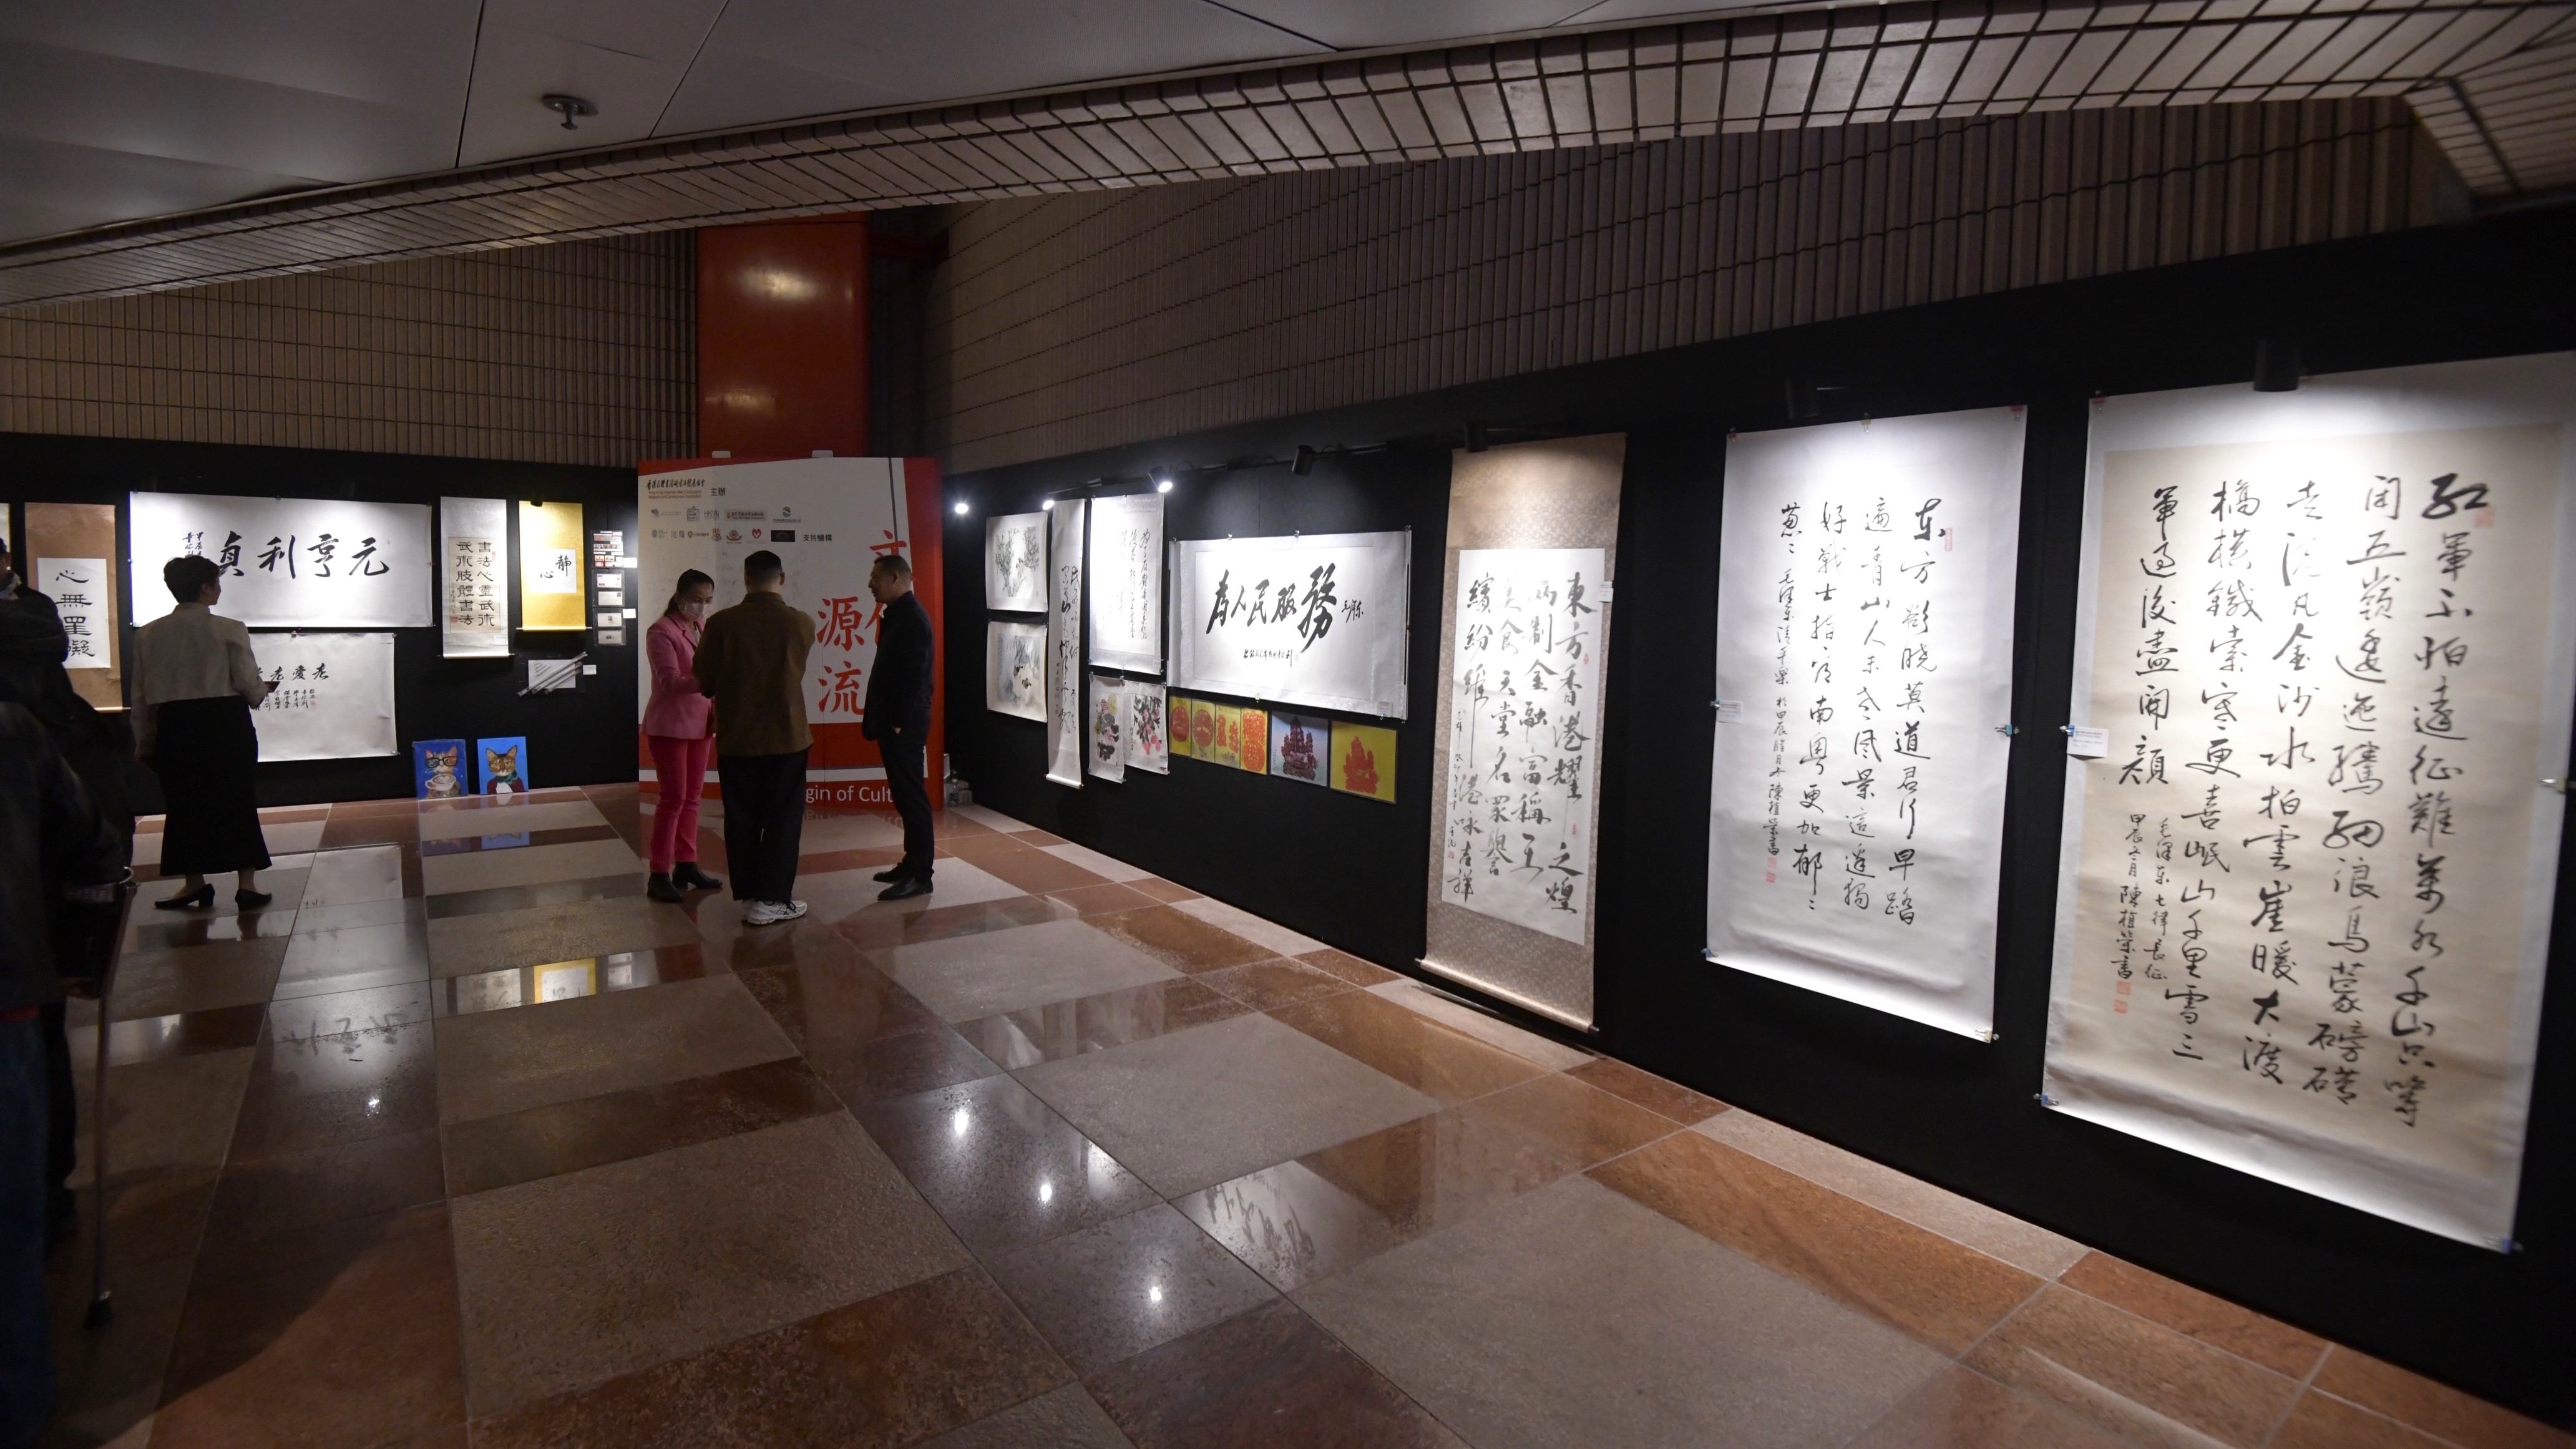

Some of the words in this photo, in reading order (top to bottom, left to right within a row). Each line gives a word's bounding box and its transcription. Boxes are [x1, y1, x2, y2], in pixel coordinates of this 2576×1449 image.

[803, 534, 832, 542] 支持機構
[817, 596, 864, 716] 源流
[806, 784, 830, 803] gin
[836, 785, 854, 801] of
[859, 786, 894, 803] Cult
